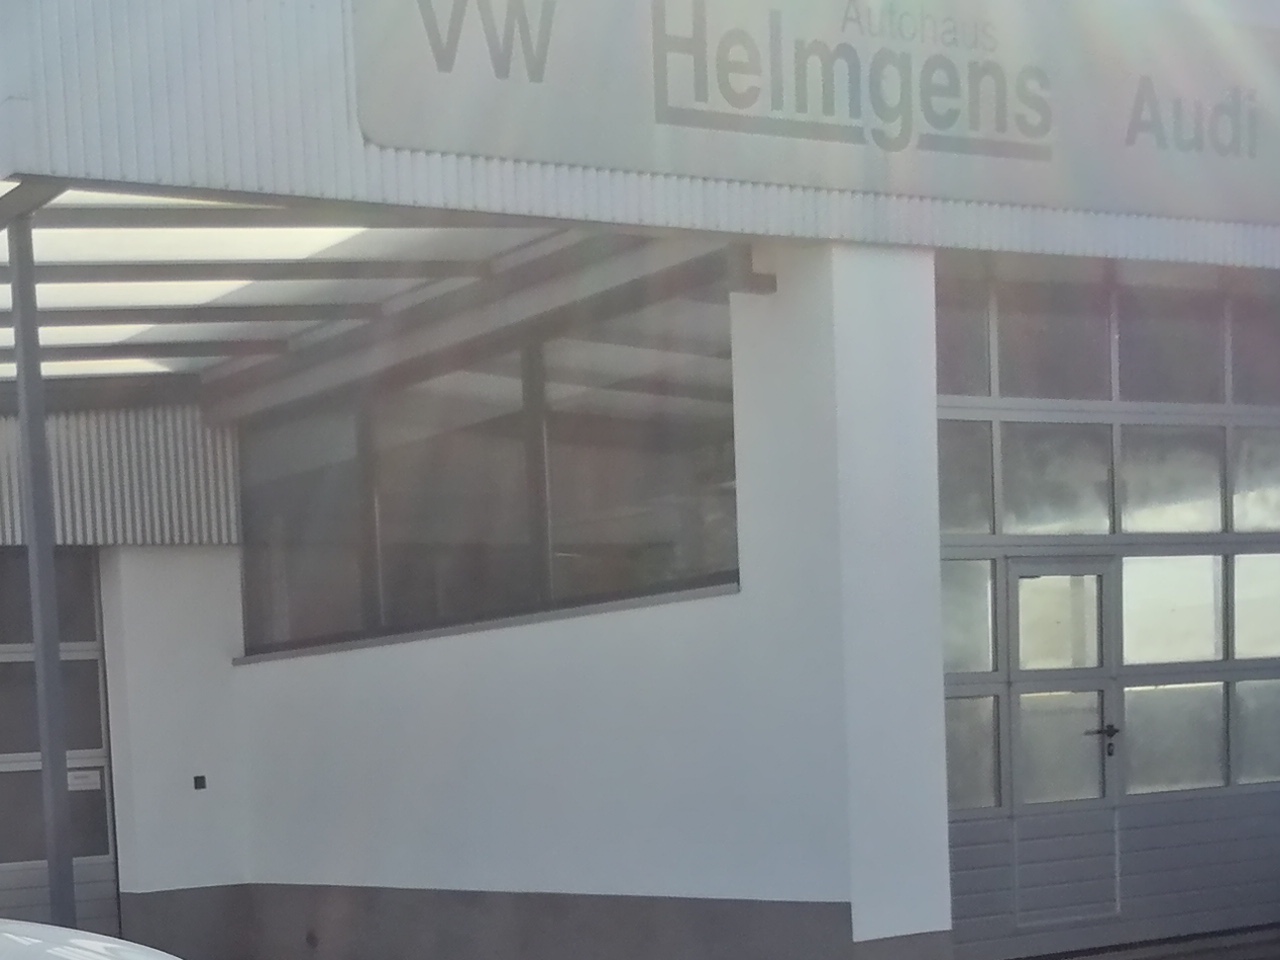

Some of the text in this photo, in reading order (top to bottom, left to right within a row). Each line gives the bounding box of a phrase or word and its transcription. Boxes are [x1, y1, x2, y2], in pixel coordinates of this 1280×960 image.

[416, 0, 556, 83] VW
[841, 0, 999, 52] Autohaus
[652, 0, 1052, 152] Helmgens
[1125, 74, 1258, 159] Audi
